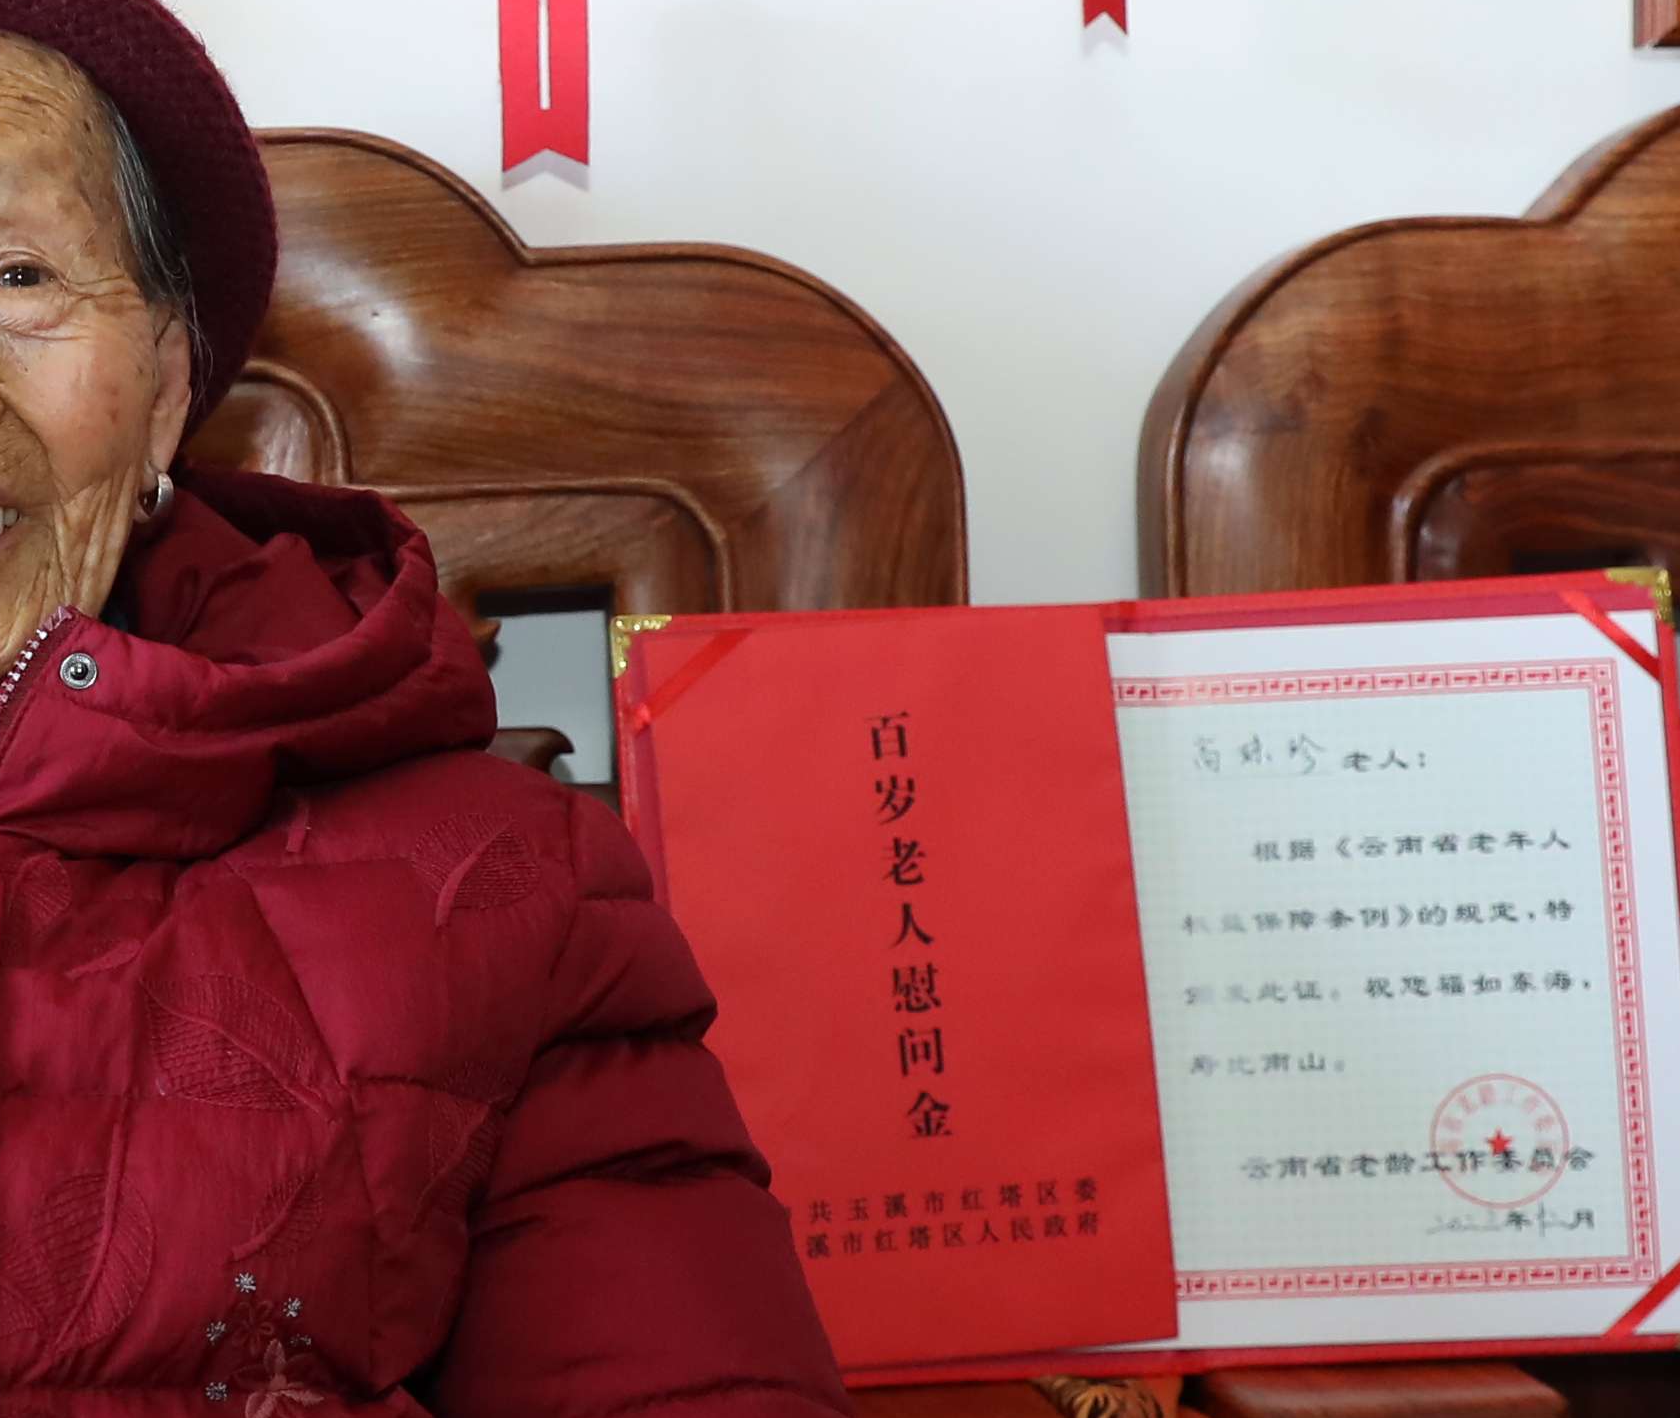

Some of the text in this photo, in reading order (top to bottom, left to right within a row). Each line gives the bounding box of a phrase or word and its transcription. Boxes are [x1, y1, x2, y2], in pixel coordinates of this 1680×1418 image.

[864, 711, 953, 1140] 百岁老人慰问金
